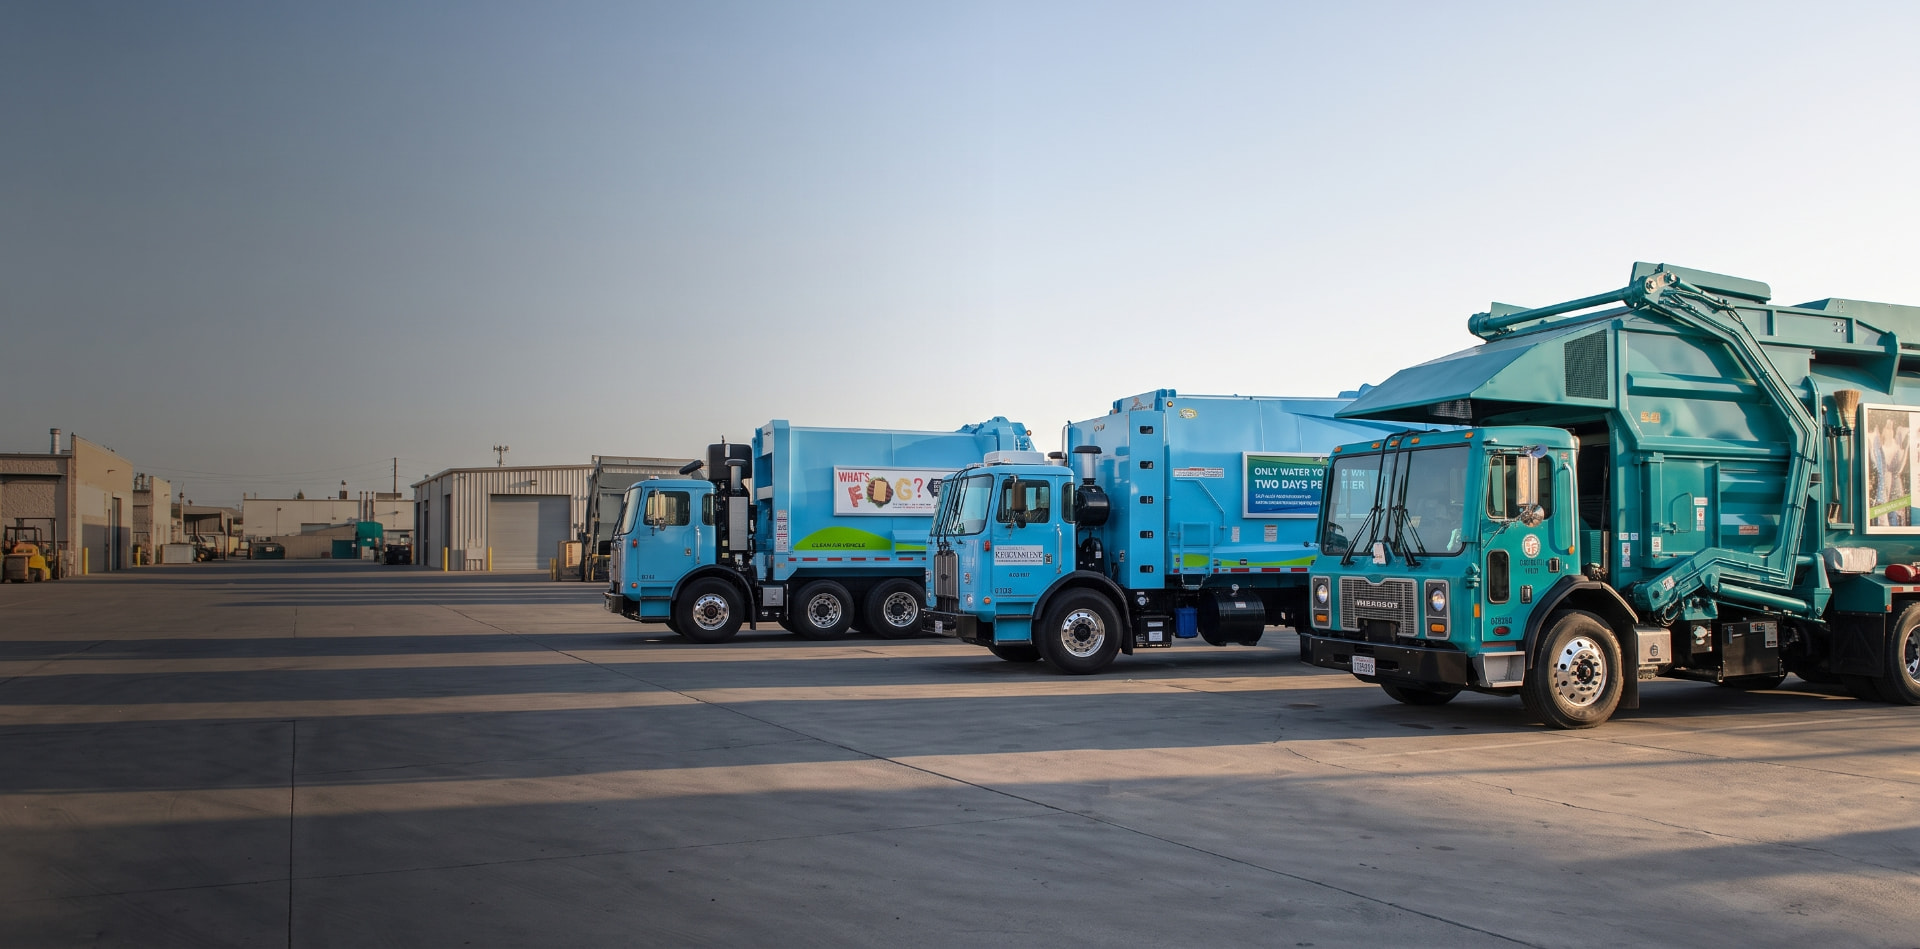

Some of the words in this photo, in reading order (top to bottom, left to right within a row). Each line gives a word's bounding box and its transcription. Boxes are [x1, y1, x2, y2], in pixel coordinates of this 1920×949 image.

[838, 471, 870, 483] WHAT'S
[1254, 467, 1278, 476] ONLY
[1280, 468, 1310, 476] WATER
[1312, 468, 1323, 476] YO
[1254, 479, 1279, 489] TWO
[1281, 479, 1308, 490] DAYS
[1310, 480, 1322, 490] PE
